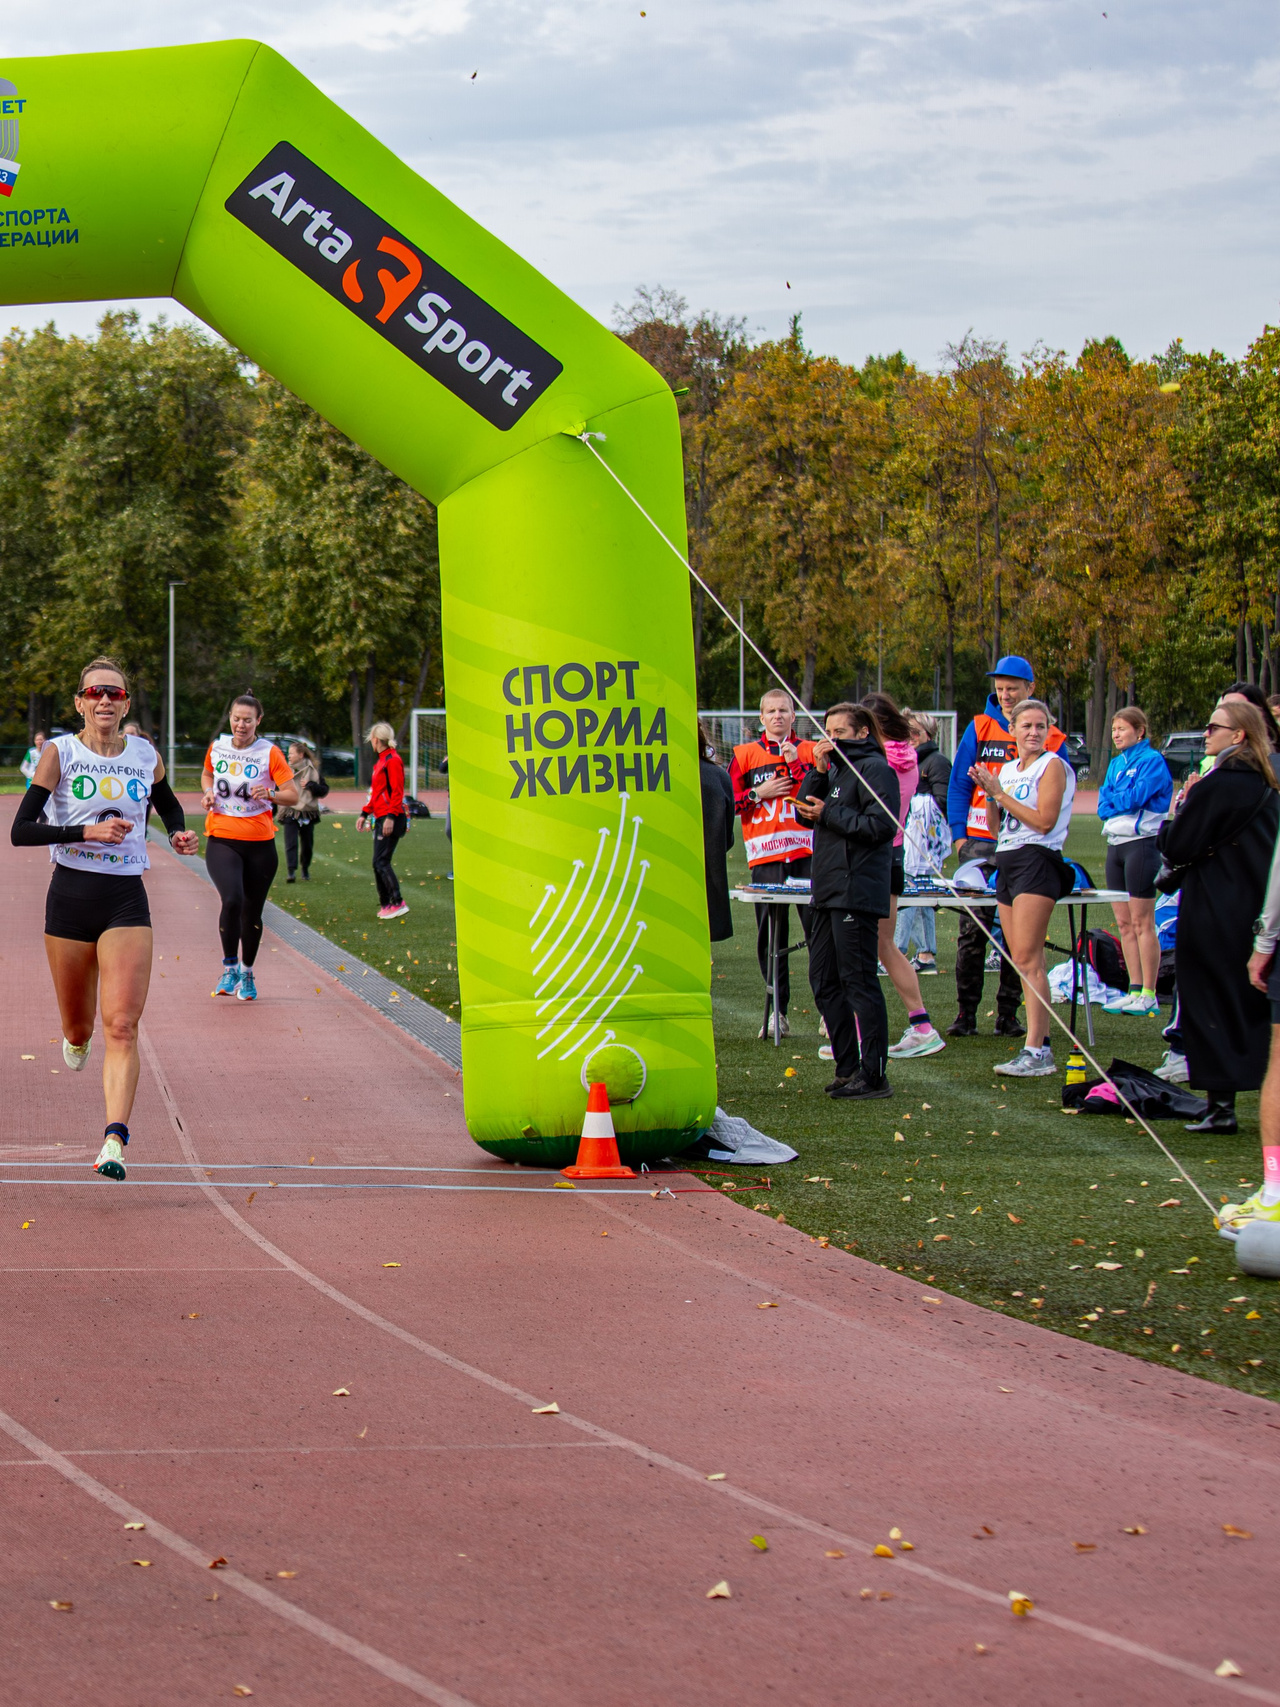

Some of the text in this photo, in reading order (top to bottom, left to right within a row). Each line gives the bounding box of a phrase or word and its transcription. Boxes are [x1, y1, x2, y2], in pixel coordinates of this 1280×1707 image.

[248, 171, 534, 407] Arta Sport
[502, 661, 640, 706] СПОРТ
[505, 707, 668, 753] НОРМА
[218, 753, 262, 765] VMARAFONE
[981, 746, 1005, 757] Arta
[70, 763, 146, 780] VMARAFONE
[509, 752, 671, 800] ЖИЗНИ
[217, 778, 252, 802] 94
